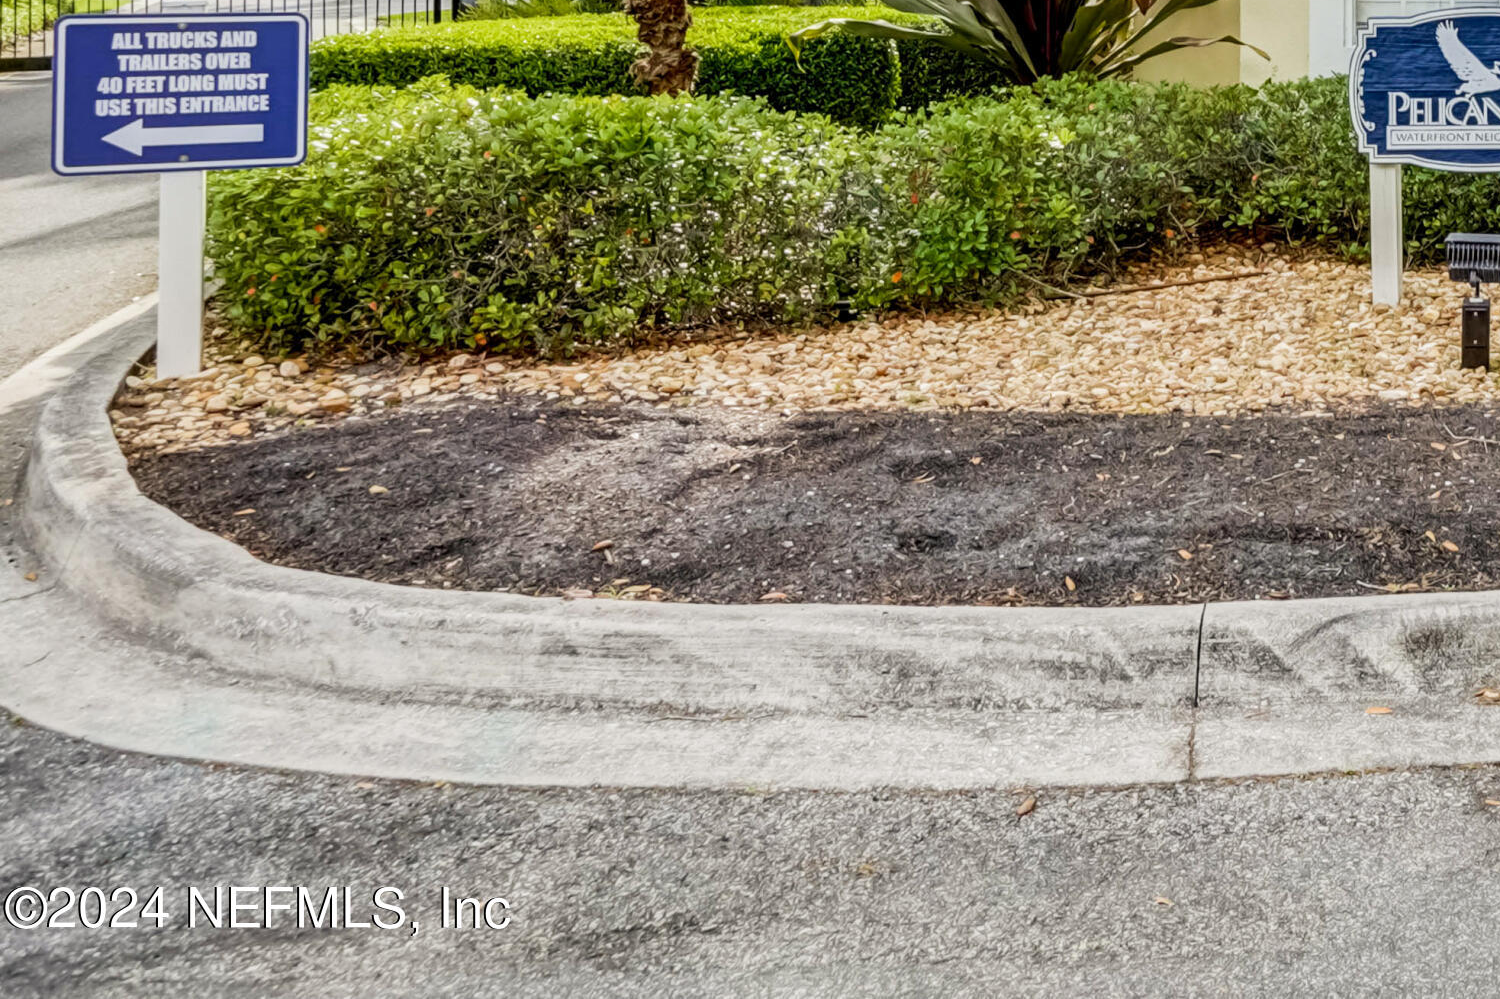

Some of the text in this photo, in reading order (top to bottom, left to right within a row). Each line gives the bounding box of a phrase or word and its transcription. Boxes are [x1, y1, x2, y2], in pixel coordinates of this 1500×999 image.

[111, 30, 257, 50] ALL TRUCKS AND
[117, 52, 251, 72] TRAILERS OVER
[97, 73, 269, 94] 40 FEET LONG MUST
[95, 95, 270, 117] USE THIS ENTRANCE
[1395, 132, 1472, 143] WATERFRONT
